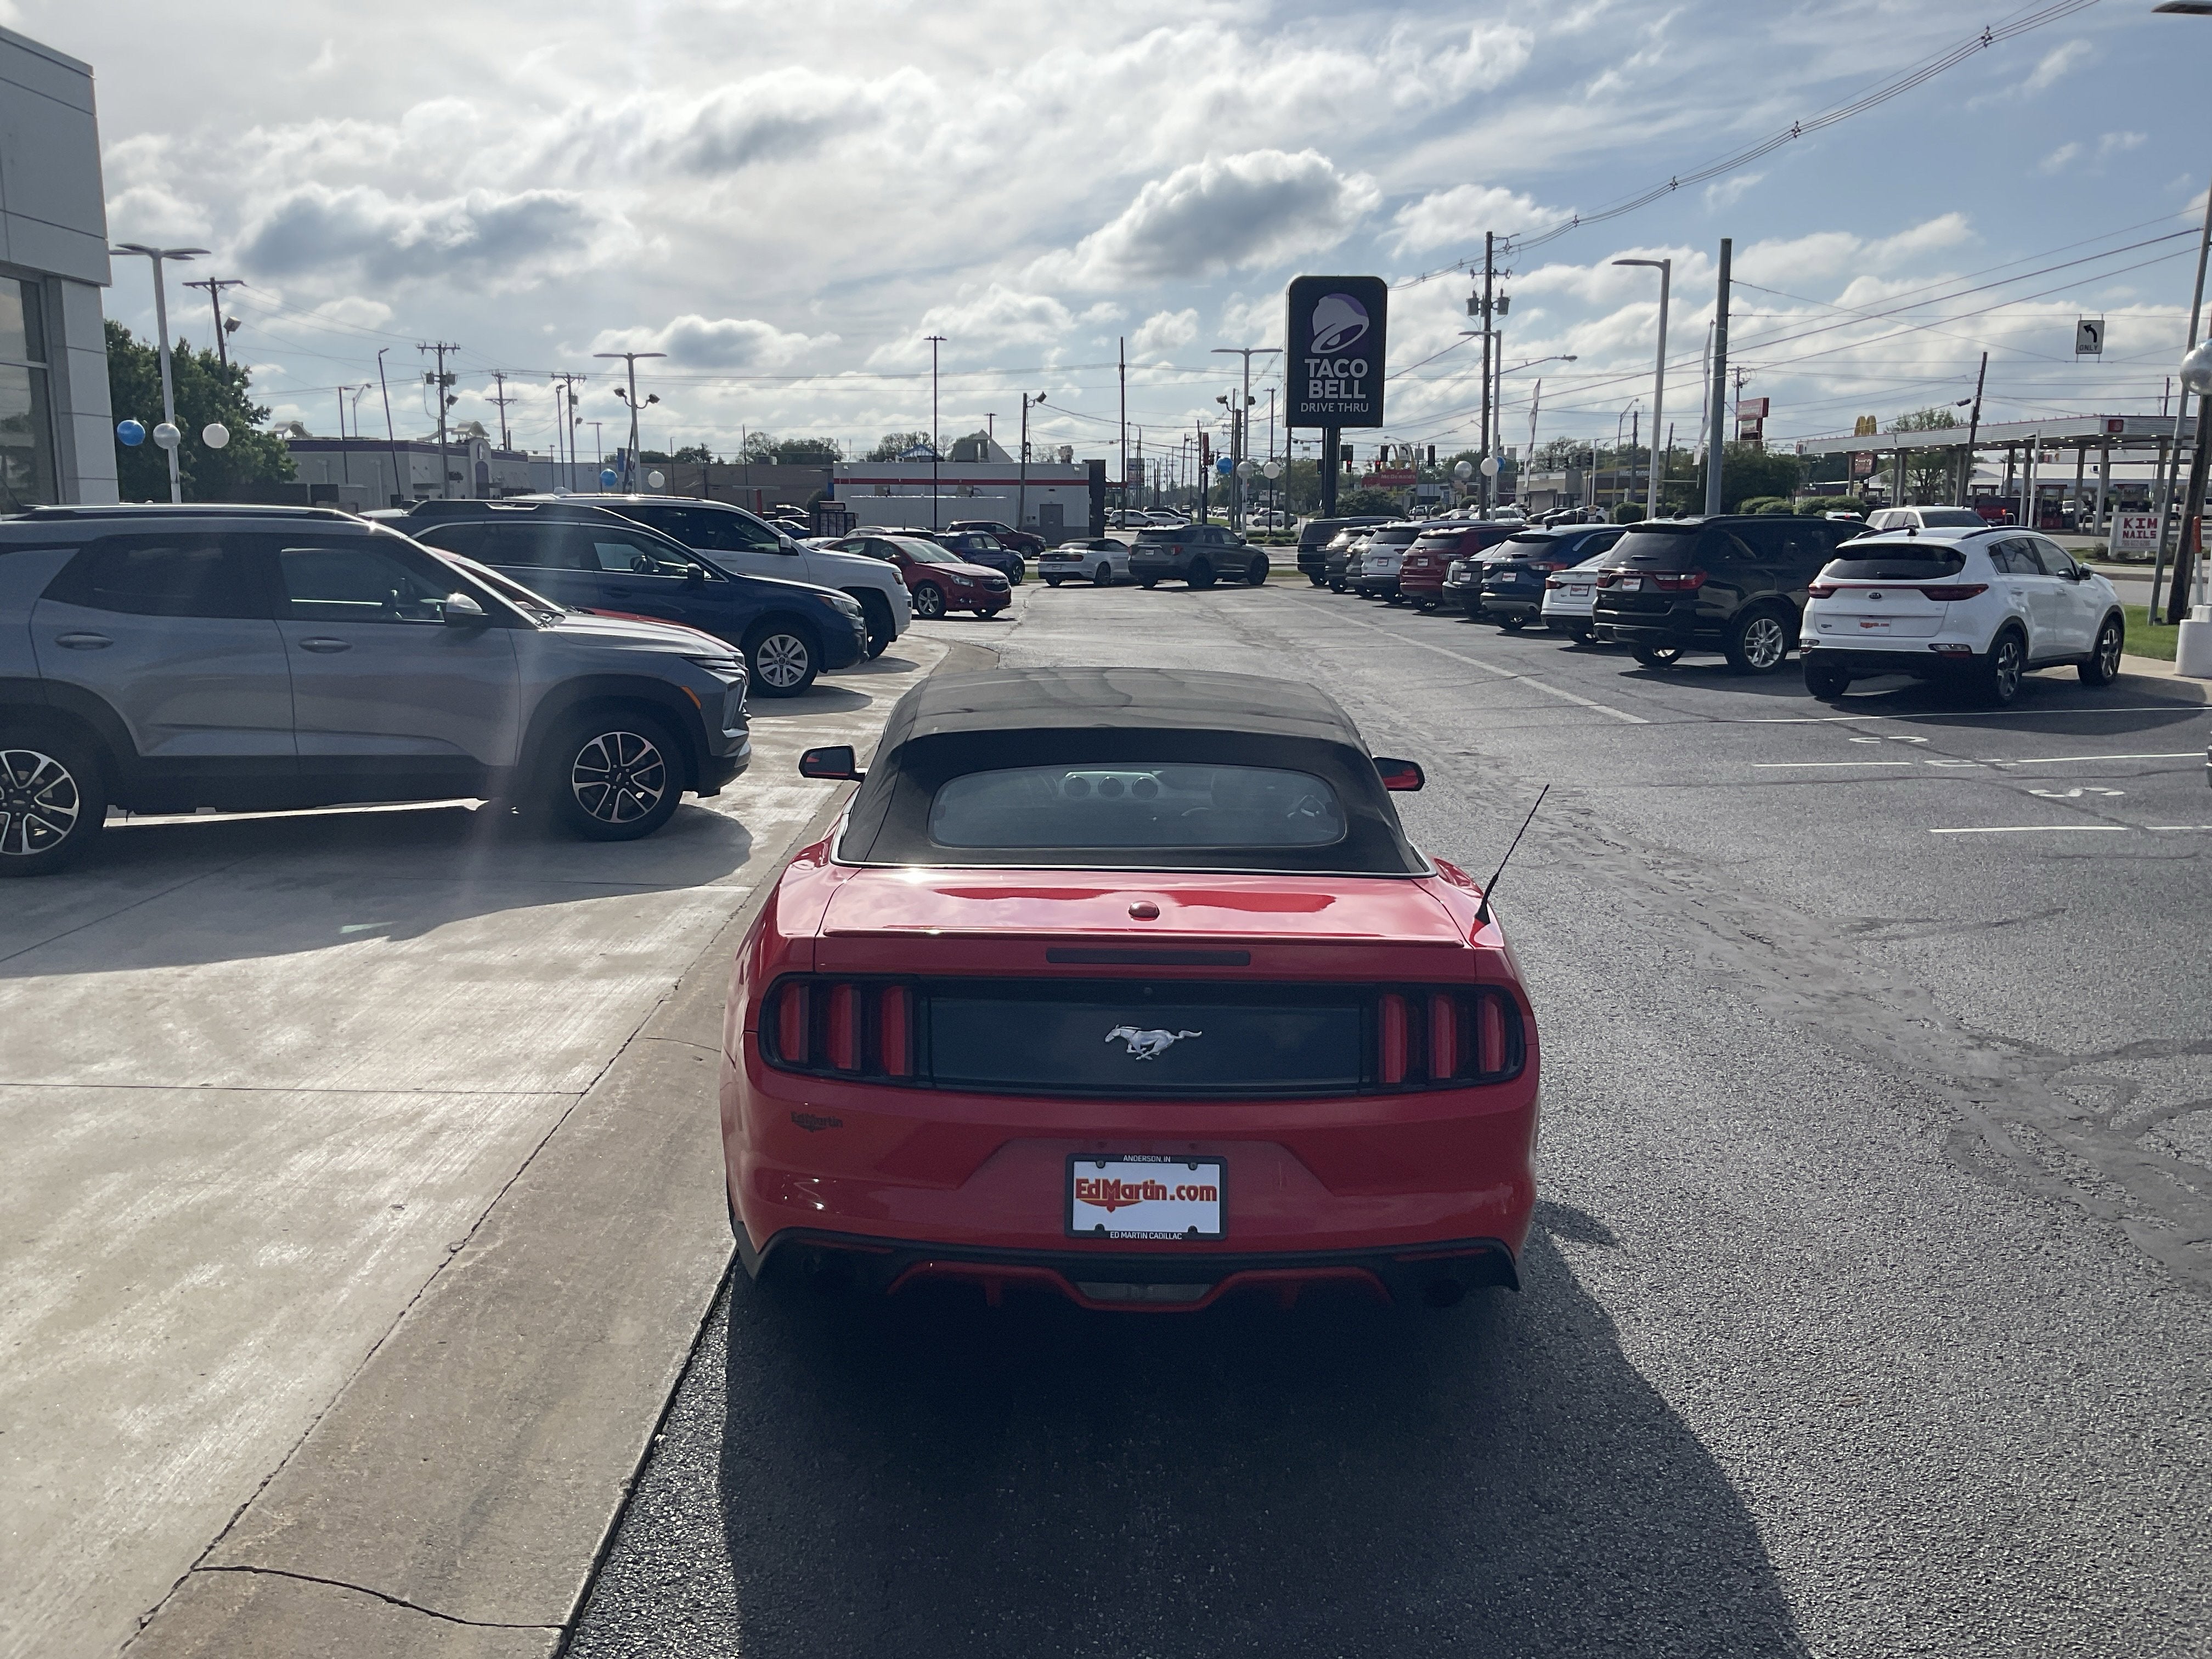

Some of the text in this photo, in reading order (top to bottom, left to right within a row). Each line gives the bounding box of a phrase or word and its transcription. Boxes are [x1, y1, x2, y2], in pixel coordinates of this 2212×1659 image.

[1305, 358, 1368, 378] TACO
[1308, 380, 1366, 399] BELL
[1300, 402, 1369, 413] DRIVE THRU
[2124, 517, 2158, 529] KIM
[2122, 530, 2157, 539] NAILS
[1075, 1177, 1217, 1203] EdMartin.com
